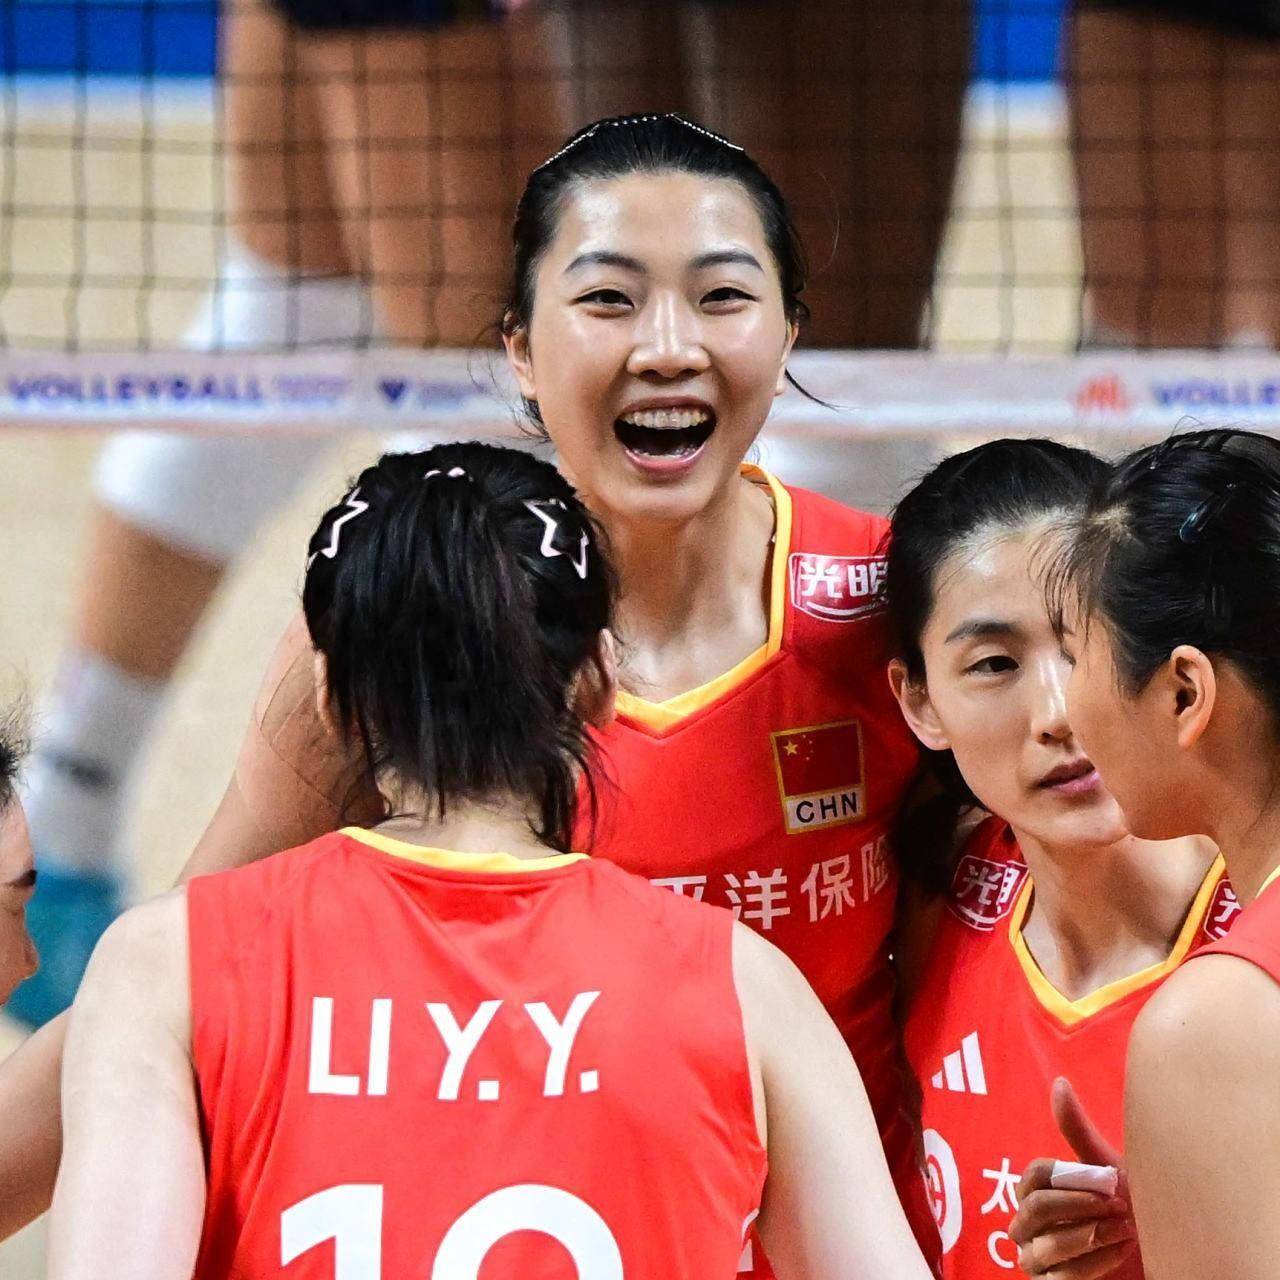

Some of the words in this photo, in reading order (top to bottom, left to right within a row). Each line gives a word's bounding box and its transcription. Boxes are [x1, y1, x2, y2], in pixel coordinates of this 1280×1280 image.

[7, 373, 262, 403] VOLLEYBALL
[796, 792, 859, 824] CHN
[308, 996, 392, 1096] LI
